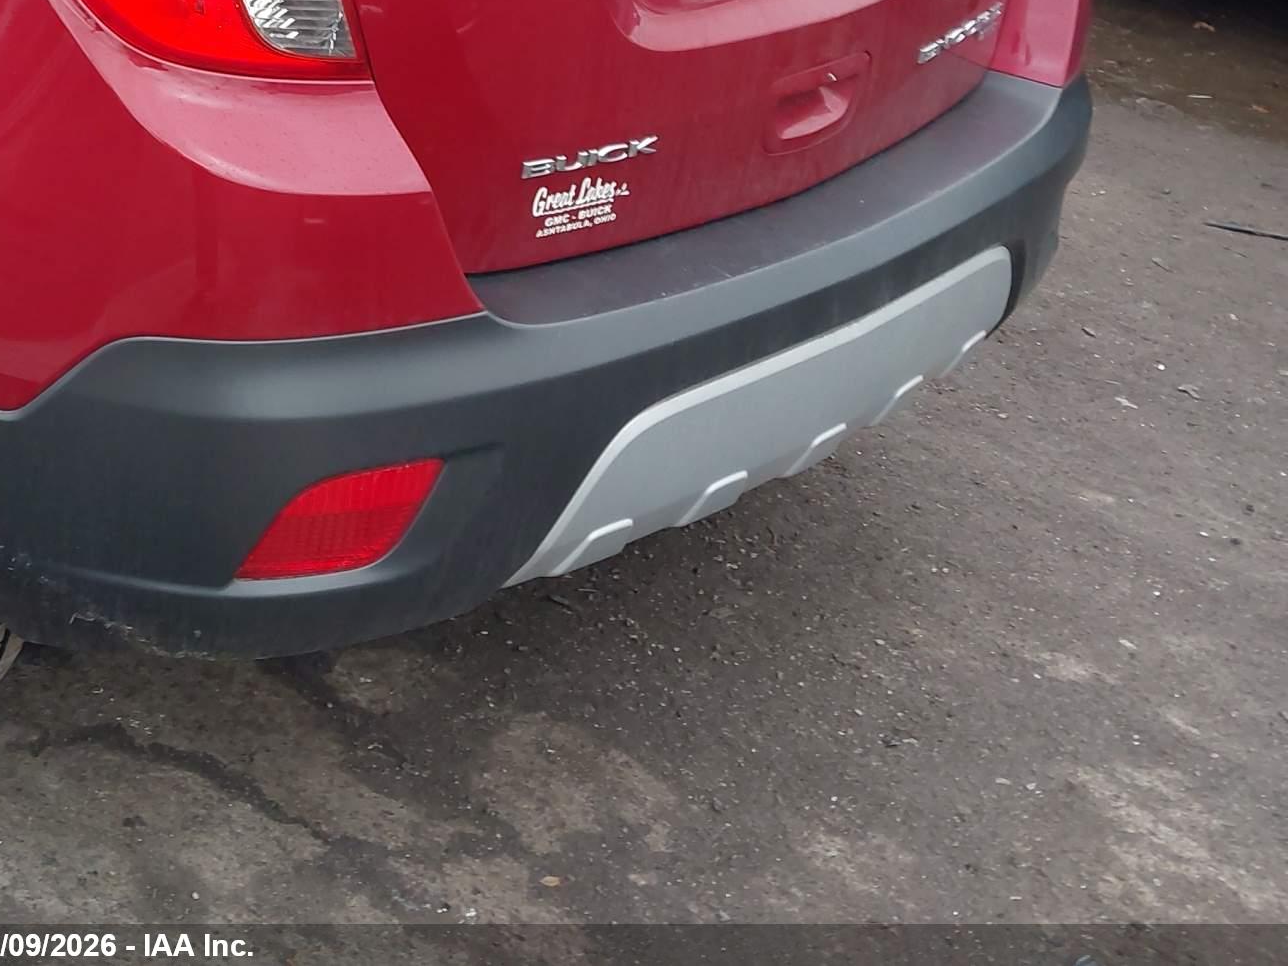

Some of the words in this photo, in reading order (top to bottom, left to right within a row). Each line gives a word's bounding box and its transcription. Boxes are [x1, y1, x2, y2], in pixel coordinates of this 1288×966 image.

[521, 135, 659, 179] BUICK
[532, 185, 577, 217] Great
[575, 177, 617, 204] Lakes
[544, 213, 570, 227] GMC
[578, 204, 613, 220] BUICK
[593, 213, 617, 225] OHIO
